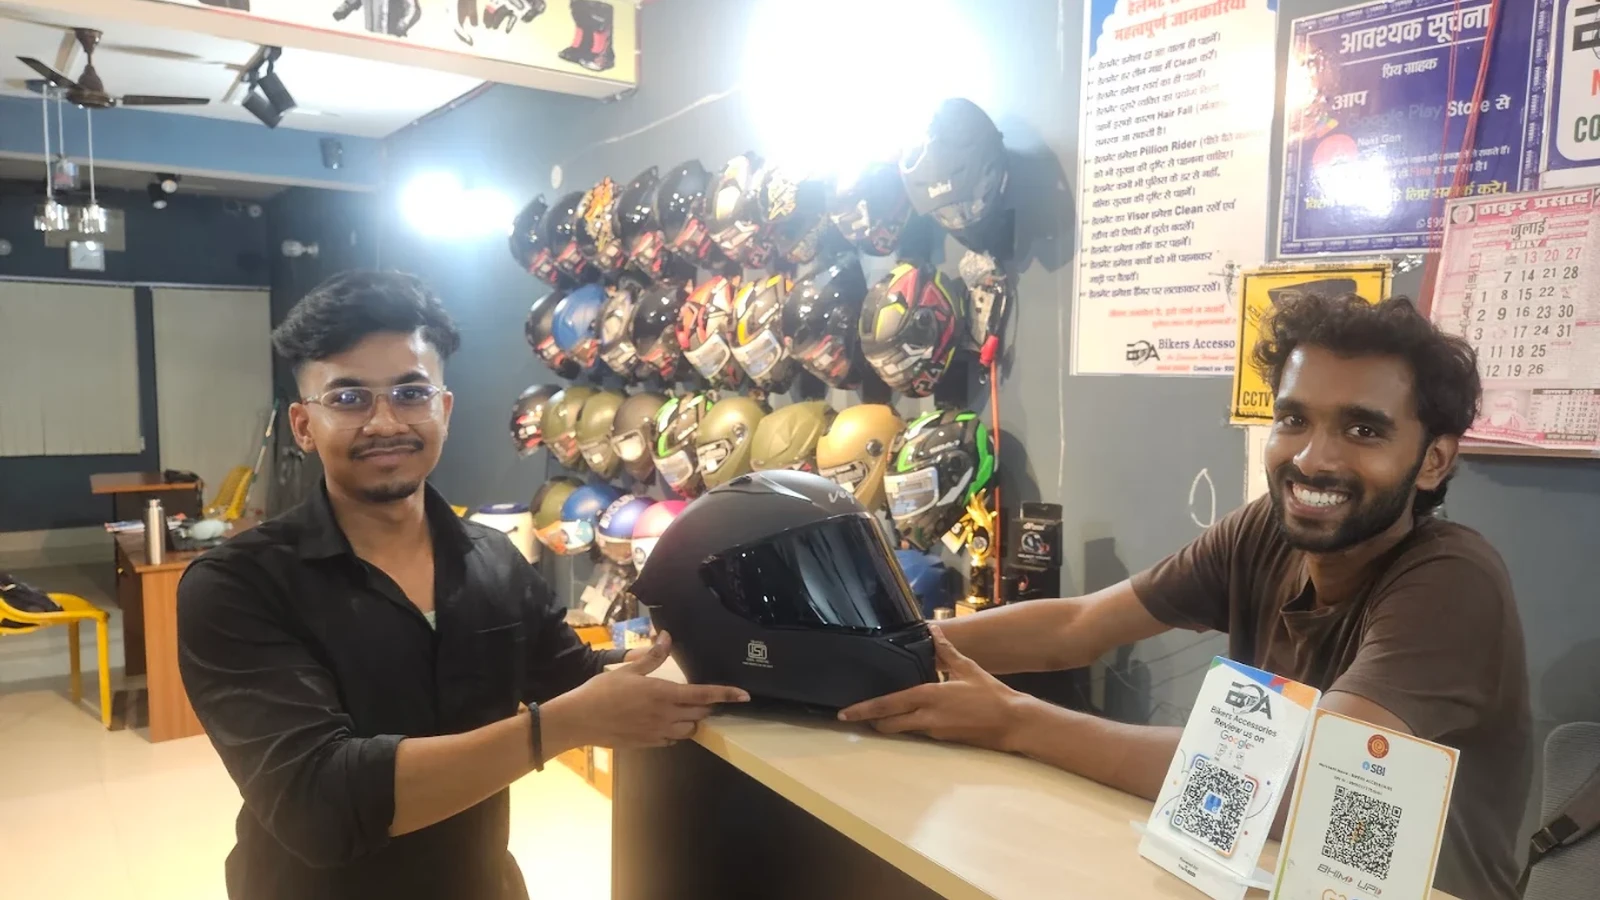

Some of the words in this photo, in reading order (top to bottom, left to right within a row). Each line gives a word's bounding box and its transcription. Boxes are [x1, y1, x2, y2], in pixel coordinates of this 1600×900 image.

[1340, 17, 1423, 54] आवश्यक
[1427, 3, 1491, 43] सूचना
[1173, 56, 1198, 68] Clean
[1382, 61, 1402, 79] प्रिय
[1404, 57, 1438, 75] ग्राहक
[1331, 90, 1369, 110] आप
[1409, 102, 1443, 120] Play
[1495, 94, 1511, 110] से
[1157, 109, 1175, 120] Hair
[1177, 104, 1193, 116] Fall
[1573, 113, 1600, 143] CO
[1139, 145, 1169, 156] Pillion
[1171, 139, 1197, 151] Rider
[1127, 212, 1150, 221] Visor
[1174, 205, 1204, 216] Clean
[1510, 216, 1548, 240] जुलाई
[1523, 250, 1538, 264] 13
[1543, 248, 1560, 262] 20
[1566, 246, 1582, 260] 27
[1504, 270, 1513, 283] 7
[1521, 269, 1535, 282] 14
[1542, 267, 1557, 279] 21
[1563, 265, 1579, 279] 28
[1482, 291, 1487, 303] 1
[1500, 289, 1509, 301] 8
[1519, 288, 1533, 301] 15
[1539, 286, 1555, 298] 22
[1477, 309, 1487, 322] 2
[1497, 307, 1507, 321] 9
[1516, 306, 1530, 318] 16
[1536, 305, 1552, 319] 23
[1558, 304, 1574, 318] 30
[1474, 327, 1484, 341] 3
[1513, 325, 1528, 339] 17
[1533, 325, 1549, 336] 24
[1556, 324, 1572, 338] 31
[1158, 338, 1190, 350] Bikers
[1192, 338, 1236, 349] Accesso
[1490, 345, 1503, 358] 11
[1510, 345, 1525, 358] 18
[1530, 344, 1547, 358] 25
[1486, 364, 1500, 377] 12
[1507, 364, 1522, 377] 19
[1528, 363, 1545, 376] 26
[1242, 391, 1273, 407] CCTV
[1210, 705, 1233, 720] Bikers
[1233, 715, 1278, 738] Accessories
[1213, 717, 1243, 734] Review
[1243, 730, 1253, 739] us
[1253, 734, 1265, 744] on
[1220, 729, 1254, 749] Google
[1370, 763, 1386, 776] SBI
[1317, 863, 1349, 883] BHIM
[1357, 880, 1379, 896] UPI
